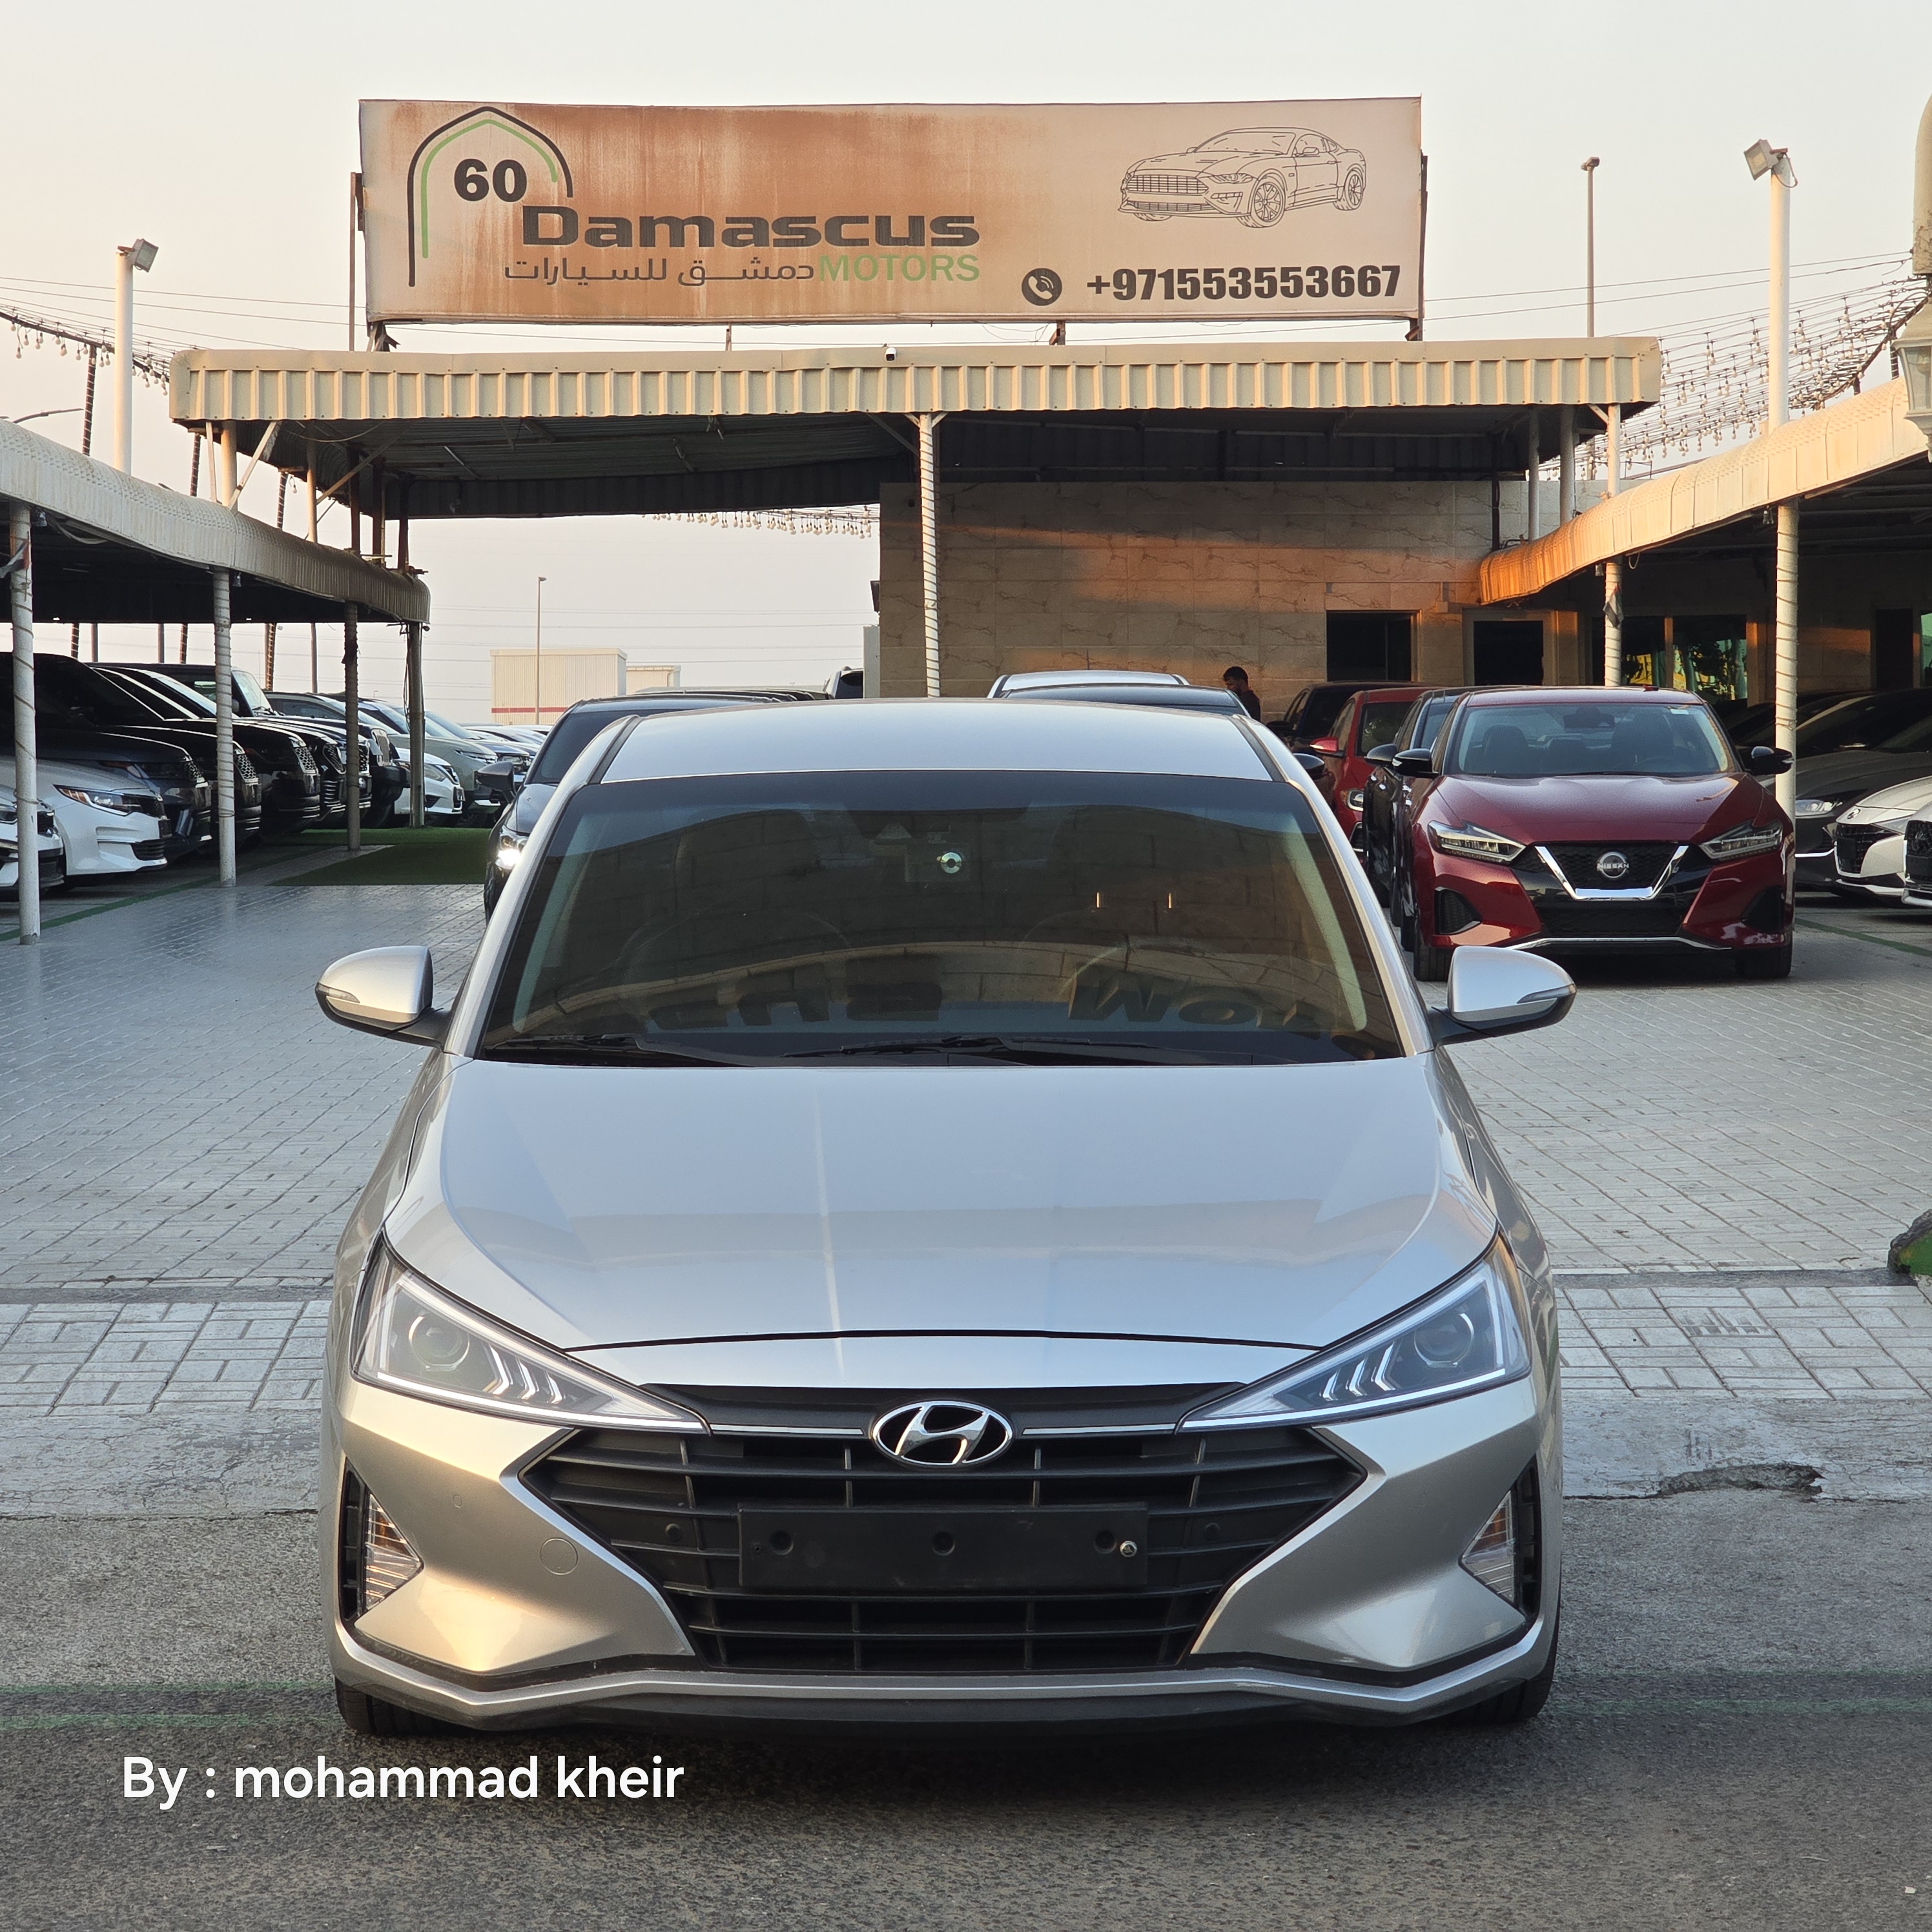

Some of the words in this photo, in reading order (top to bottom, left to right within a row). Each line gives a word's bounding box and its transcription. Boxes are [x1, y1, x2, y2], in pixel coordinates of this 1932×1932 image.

[453, 158, 527, 202] 60
[522, 205, 980, 247] Damascus
[504, 257, 667, 286] للسيارات
[677, 256, 814, 287] دمشق
[819, 254, 980, 282] MOTORS
[1087, 265, 1401, 301] +971553553667
